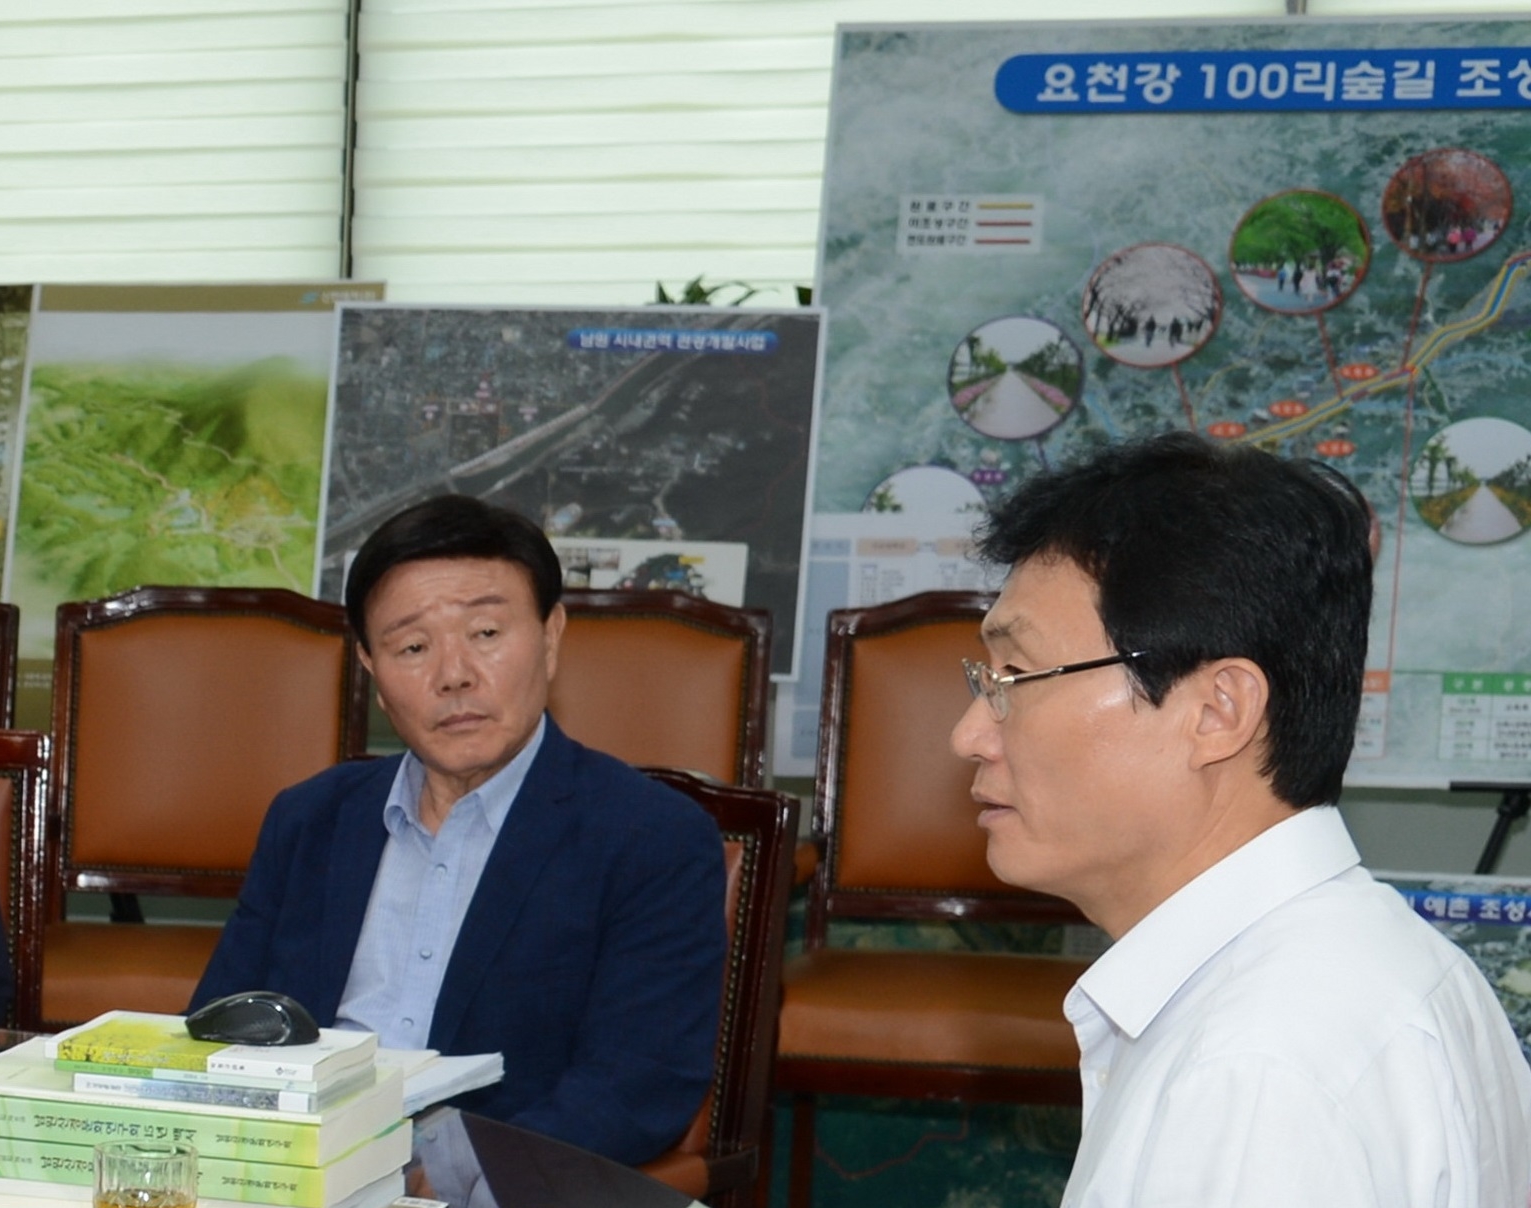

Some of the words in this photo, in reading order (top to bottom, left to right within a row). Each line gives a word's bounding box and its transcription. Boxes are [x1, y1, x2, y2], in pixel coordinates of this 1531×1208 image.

[1036, 61, 1181, 104] 요천강
[1200, 60, 1436, 102] 100리숲길
[1478, 897, 1531, 923] 조성
